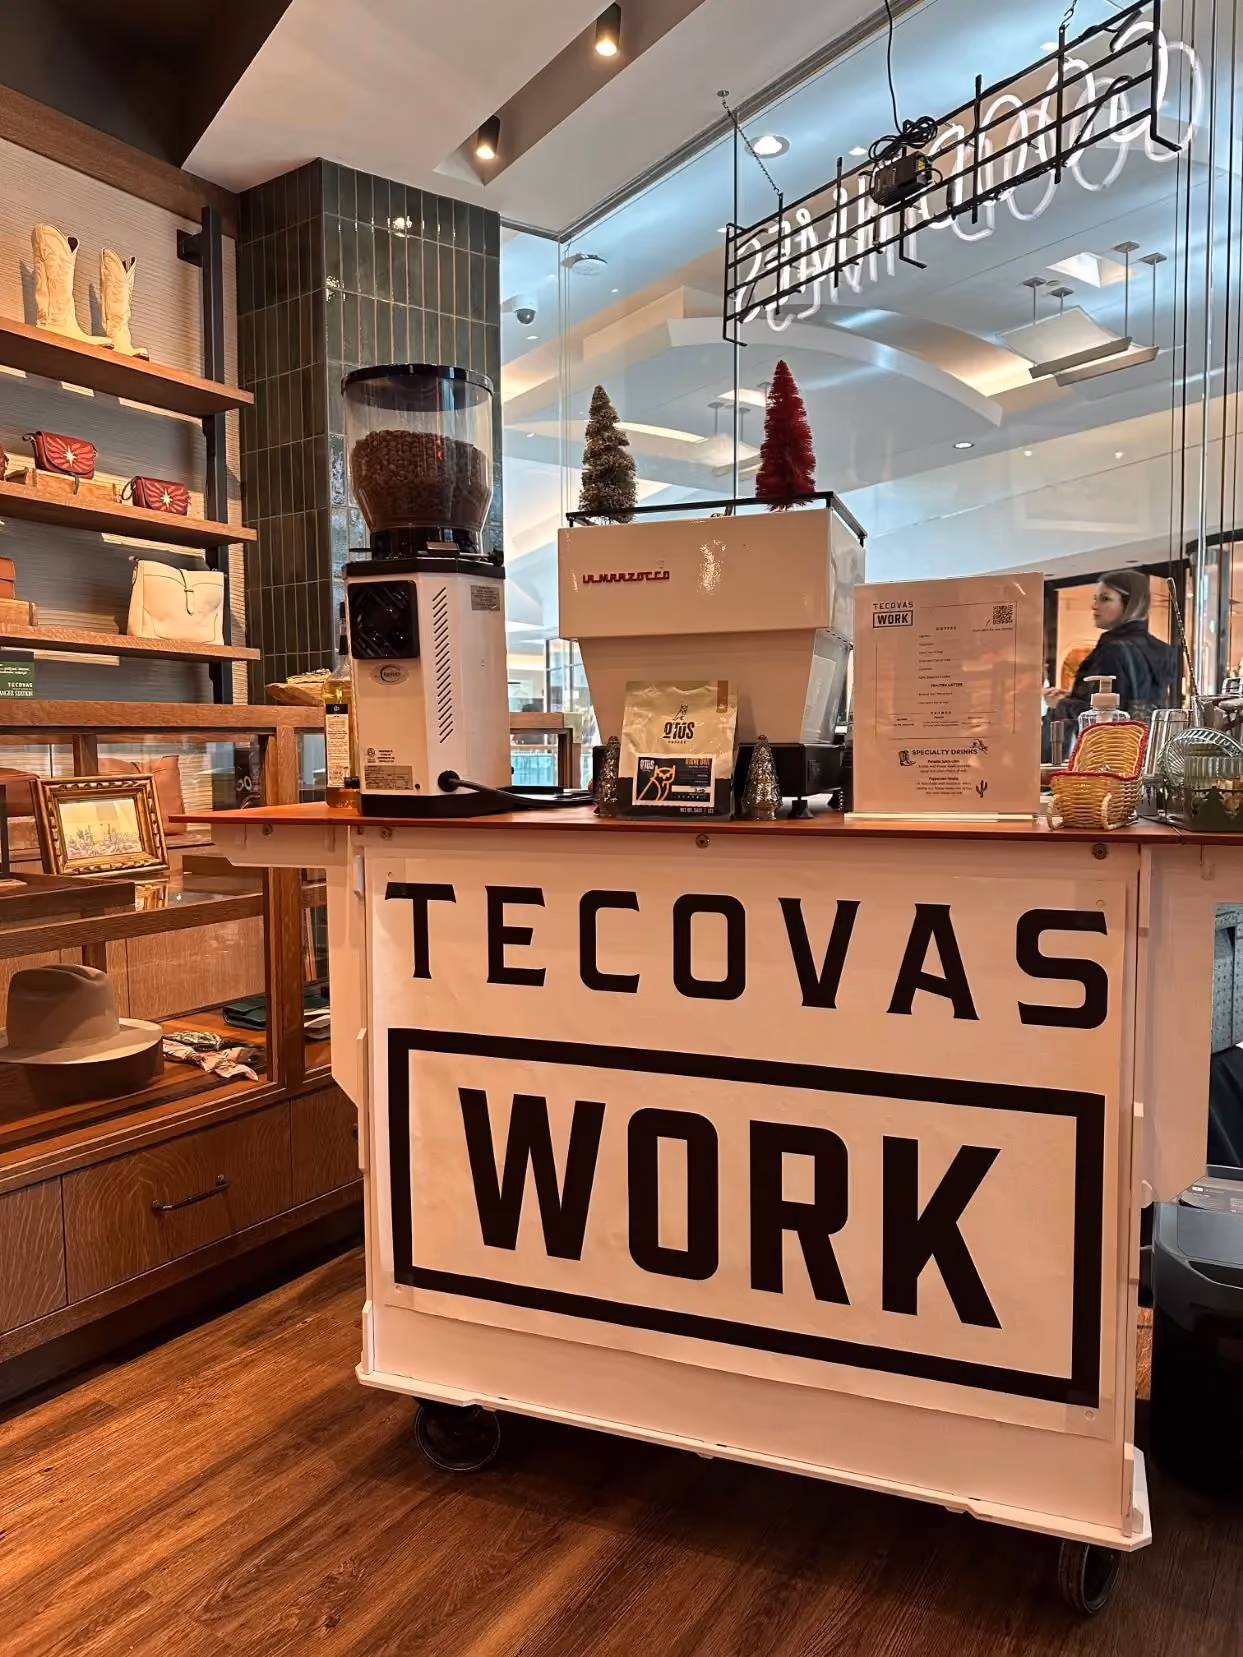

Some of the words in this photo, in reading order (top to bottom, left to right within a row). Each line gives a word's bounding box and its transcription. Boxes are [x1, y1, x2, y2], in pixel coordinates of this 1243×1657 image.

[872, 601, 914, 610] TECOVAS
[877, 613, 909, 625] WORK
[384, 881, 1109, 1030] TECOVAS
[458, 1086, 1002, 1330] WORK
